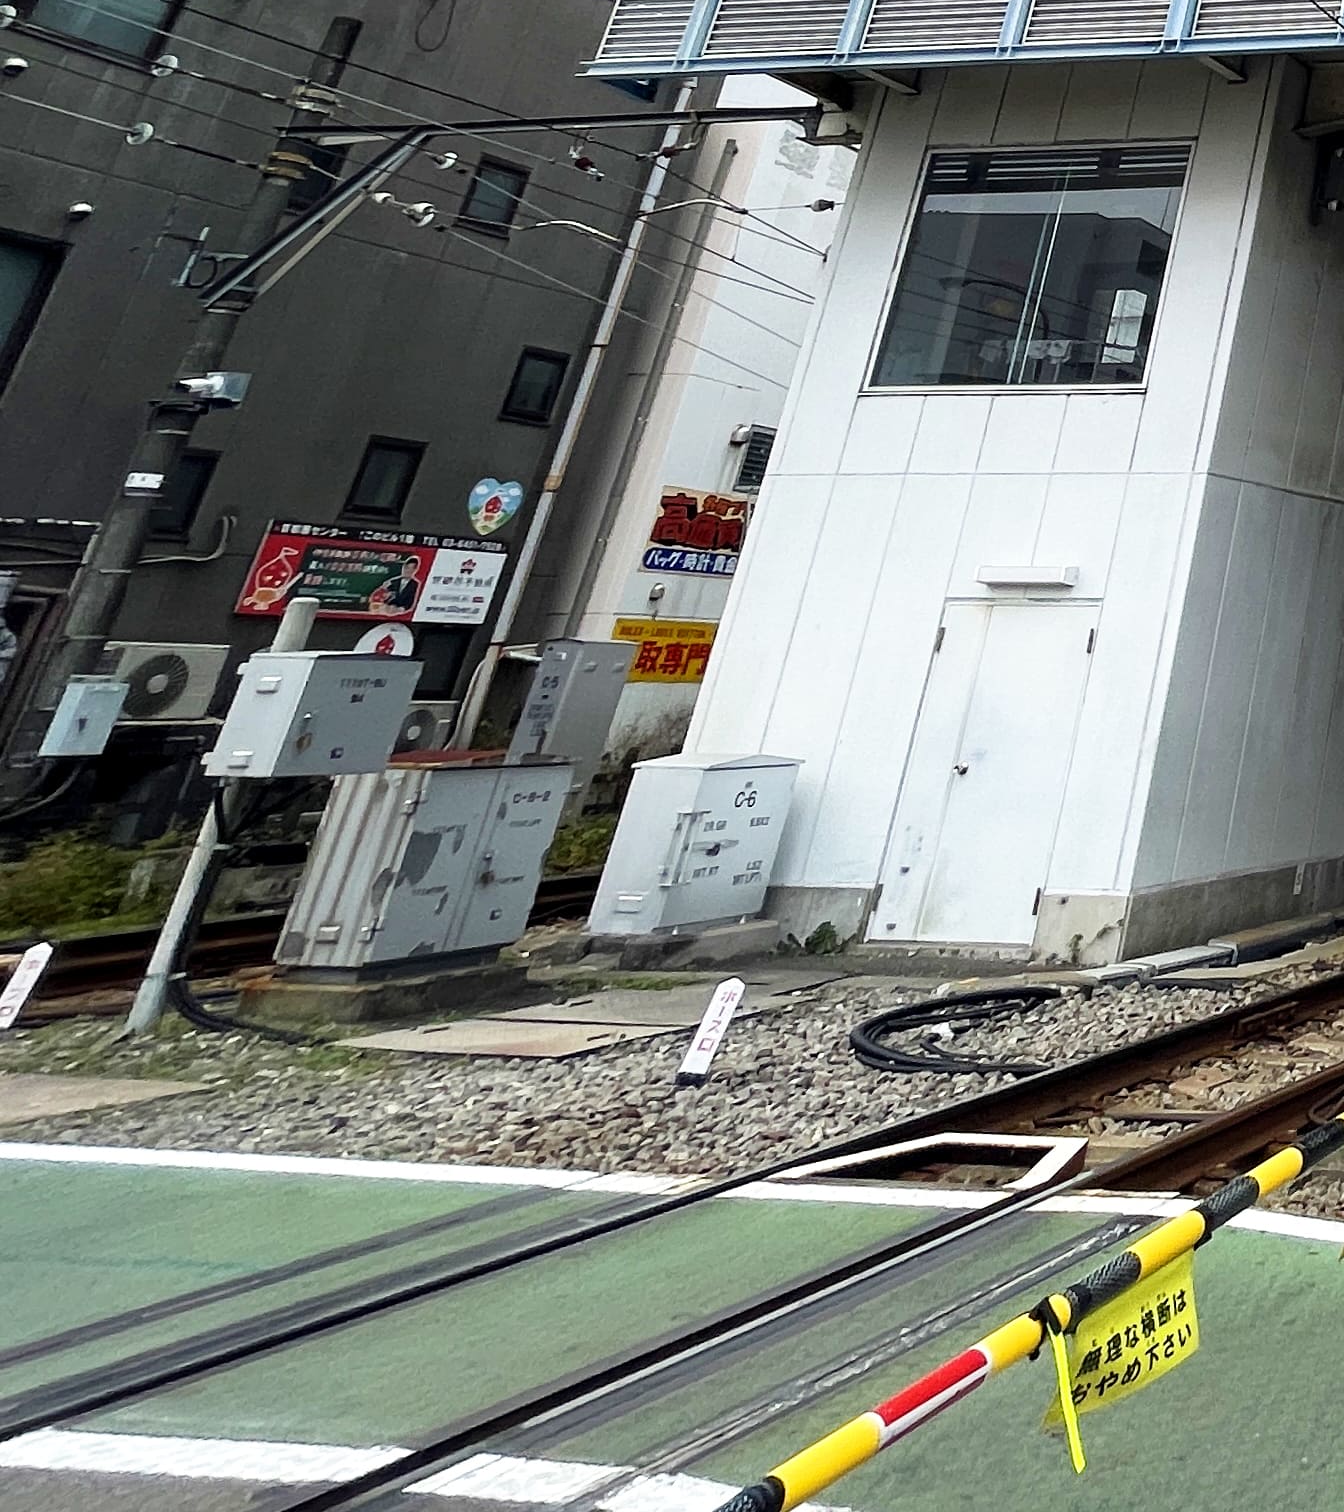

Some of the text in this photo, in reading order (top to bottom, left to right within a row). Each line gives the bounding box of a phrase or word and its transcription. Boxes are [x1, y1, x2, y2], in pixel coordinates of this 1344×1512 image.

[423, 536, 438, 546] TEL
[735, 791, 757, 808] C-6
[697, 991, 738, 1052] ホース口
[1076, 1289, 1187, 1378] 無理な横断は
[1072, 1324, 1191, 1405] おやめ下さい
